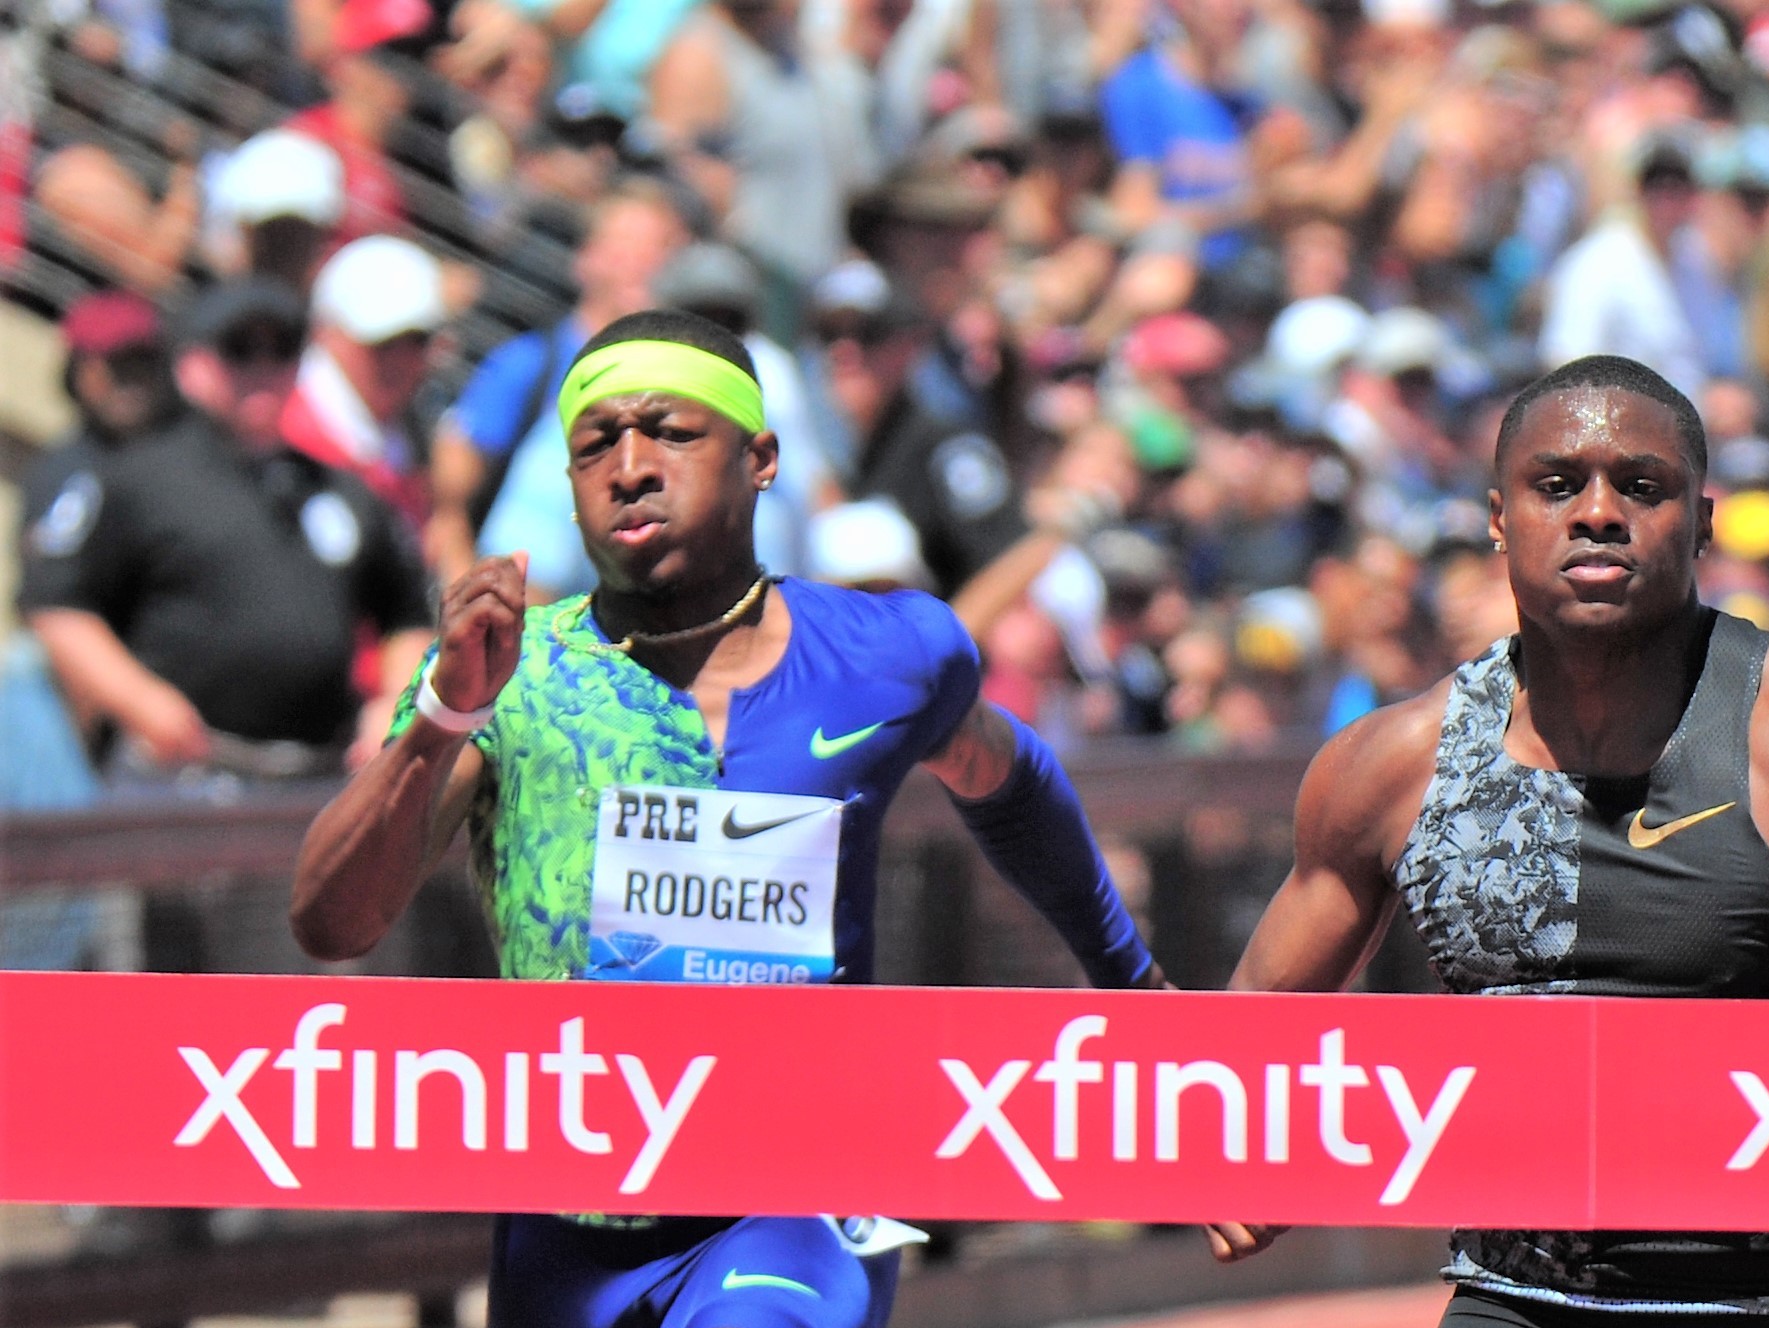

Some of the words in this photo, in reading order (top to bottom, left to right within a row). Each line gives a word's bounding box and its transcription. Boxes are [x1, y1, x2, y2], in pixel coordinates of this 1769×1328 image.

[614, 790, 698, 843] PRE
[624, 868, 809, 926] RODGERS
[682, 949, 811, 985] Eugene
[173, 1003, 717, 1195] xfinity
[935, 1015, 1477, 1206] xfinity
